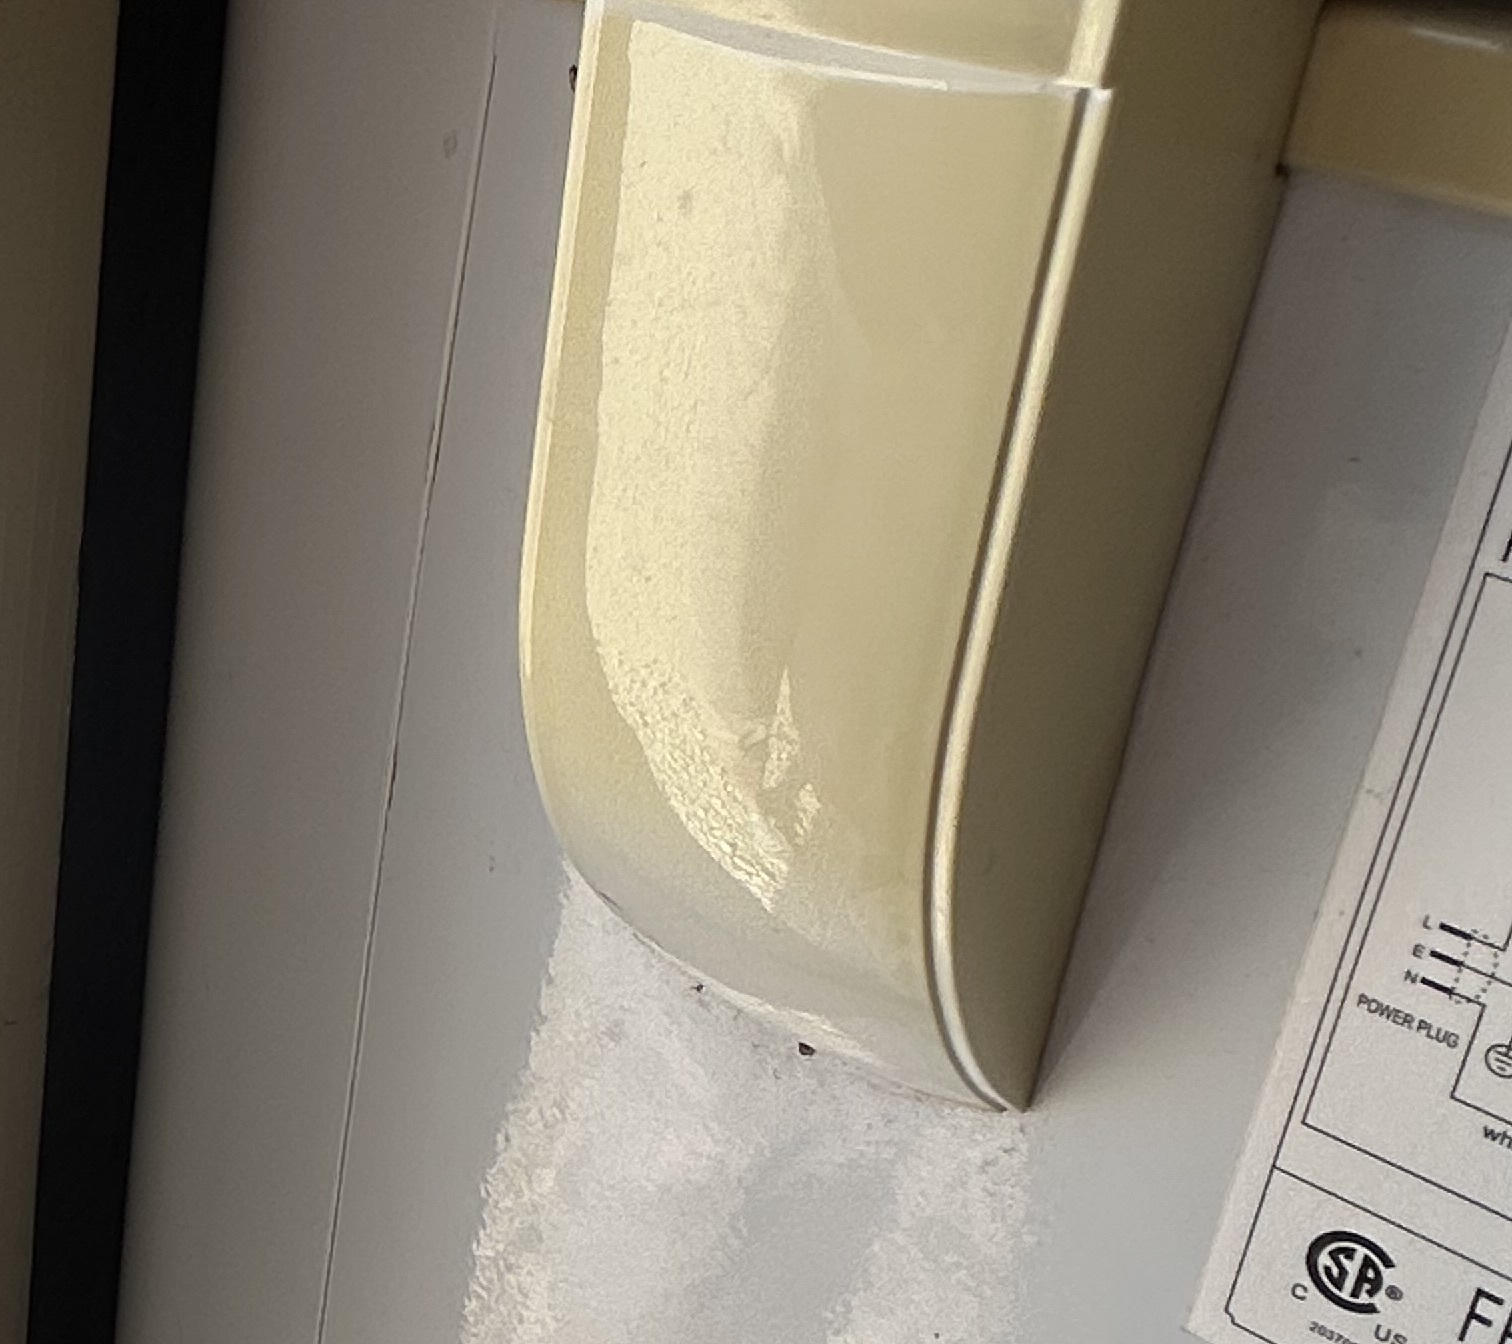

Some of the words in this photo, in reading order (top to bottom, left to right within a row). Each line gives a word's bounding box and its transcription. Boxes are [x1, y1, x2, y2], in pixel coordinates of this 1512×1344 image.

[1422, 914, 1433, 931] L
[1411, 942, 1426, 960] E
[1403, 968, 1419, 985] N
[1356, 992, 1416, 1030] POWER
[1416, 1018, 1460, 1049] PLUG
